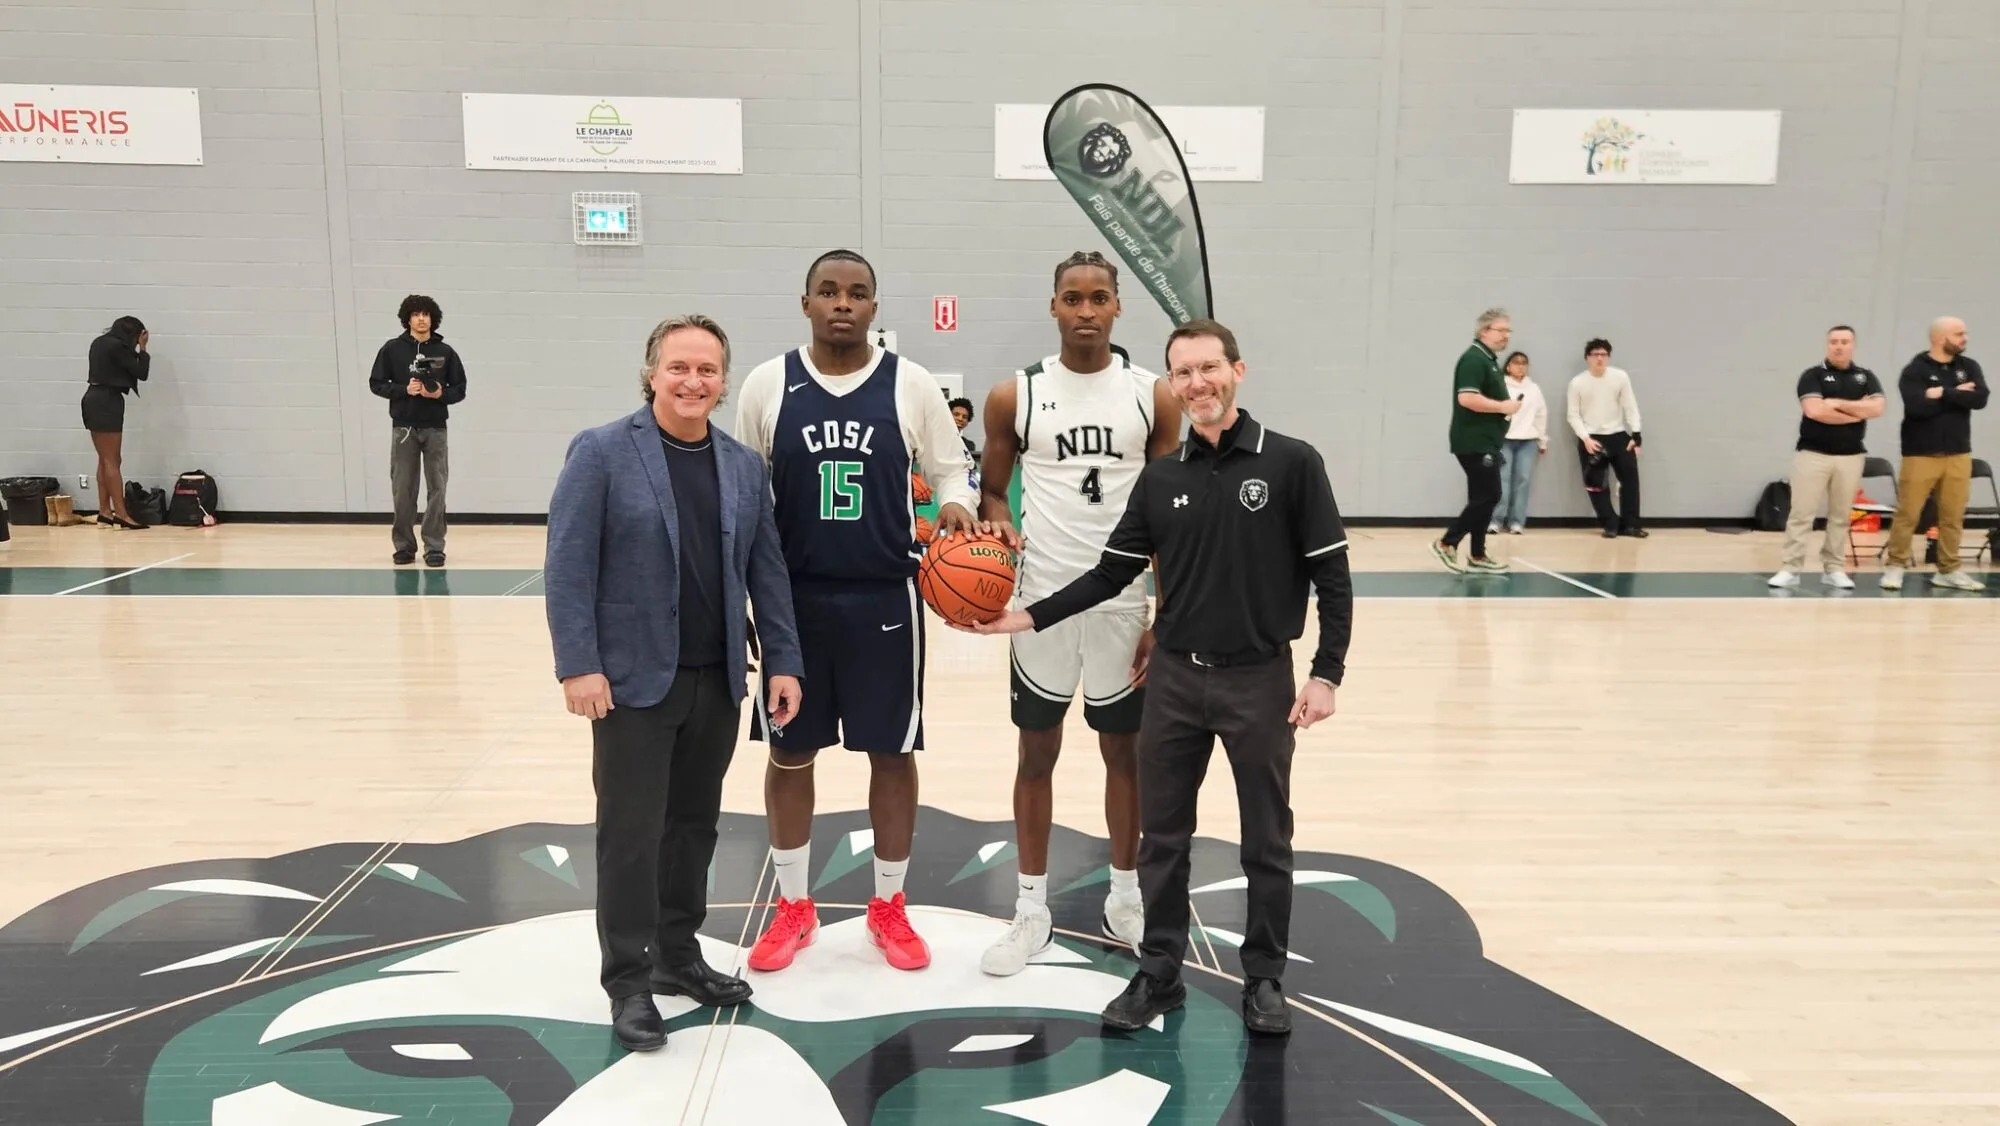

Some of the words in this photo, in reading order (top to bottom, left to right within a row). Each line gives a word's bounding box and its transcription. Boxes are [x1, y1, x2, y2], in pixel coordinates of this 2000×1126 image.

[588, 127, 633, 136] CHAPEAU
[1110, 167, 1186, 258] NDL
[1088, 193, 1112, 223] Fais
[1107, 219, 1142, 258] partie
[1138, 254, 1156, 274] de
[1150, 268, 1192, 324] l'histoire
[801, 419, 875, 455] CDSL
[1055, 425, 1123, 461] NDL
[818, 460, 864, 521] 15
[1079, 465, 1104, 506] 4
